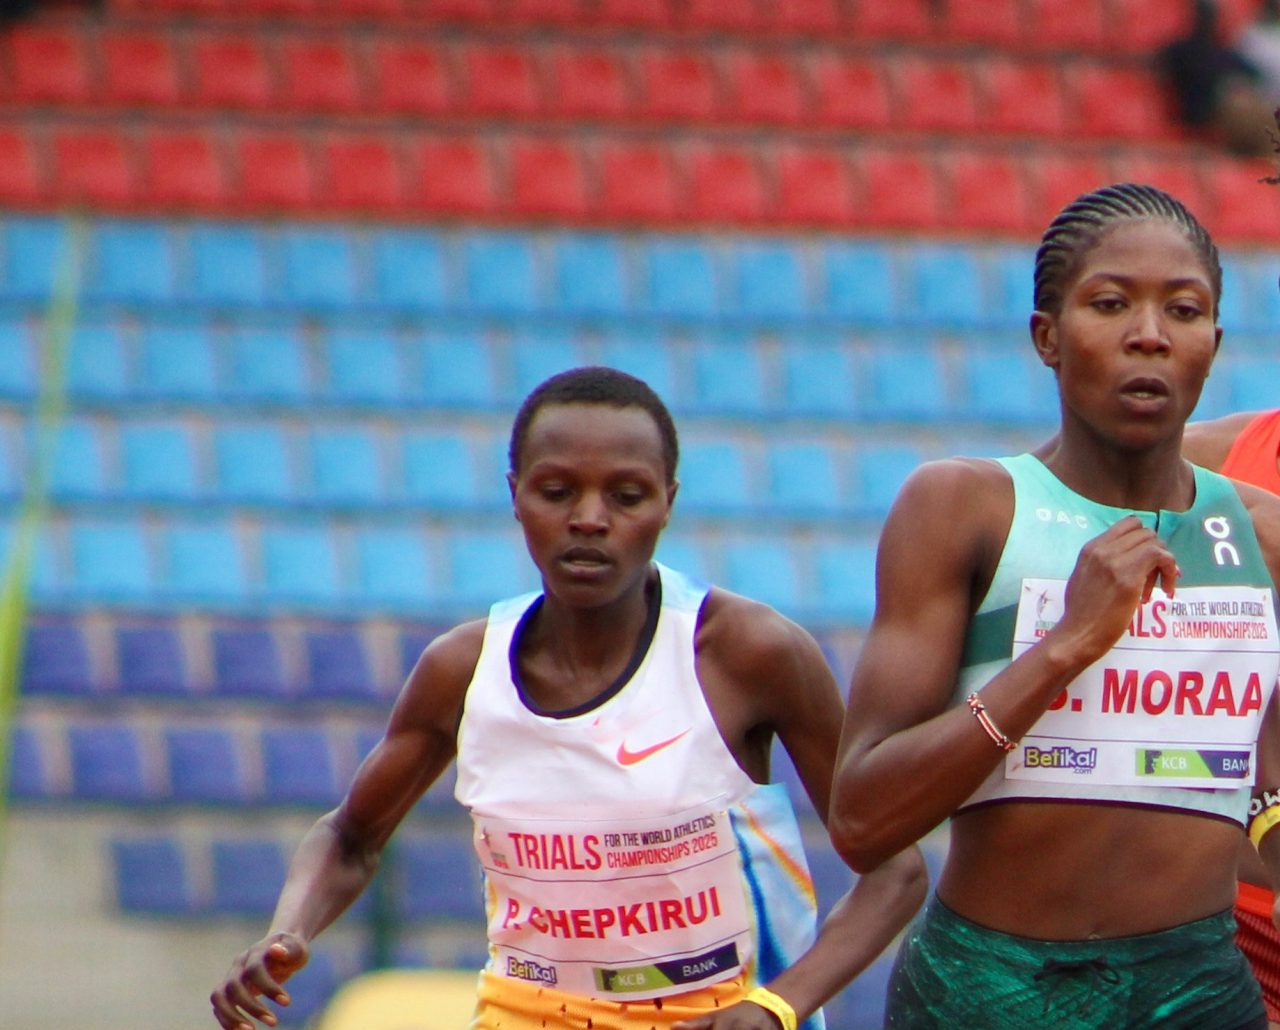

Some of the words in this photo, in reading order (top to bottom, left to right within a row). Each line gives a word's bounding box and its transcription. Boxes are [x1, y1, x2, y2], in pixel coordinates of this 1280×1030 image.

[1035, 507, 1089, 529] OAC
[1171, 602, 1188, 616] FOR
[1189, 602, 1206, 616] THE
[1208, 601, 1238, 616] WORLD
[1172, 621, 1251, 640] CHAMPIONSHIPS
[1101, 667, 1263, 717] MORAA
[1024, 746, 1097, 769] Betika!
[1161, 756, 1188, 770] KCB
[508, 832, 602, 872] TRIALS
[603, 833, 622, 847] FOR
[622, 832, 640, 847] THE
[641, 827, 672, 846] WORLD
[673, 815, 716, 842] ATHLETICS
[606, 841, 691, 869] CHAMPIONSHIPS
[691, 831, 719, 854] 2025
[502, 897, 523, 931] P.
[526, 886, 722, 940] CHEPKIRUI
[507, 956, 558, 984] Betika!
[617, 973, 646, 987] KCB
[681, 957, 719, 978] BANK
